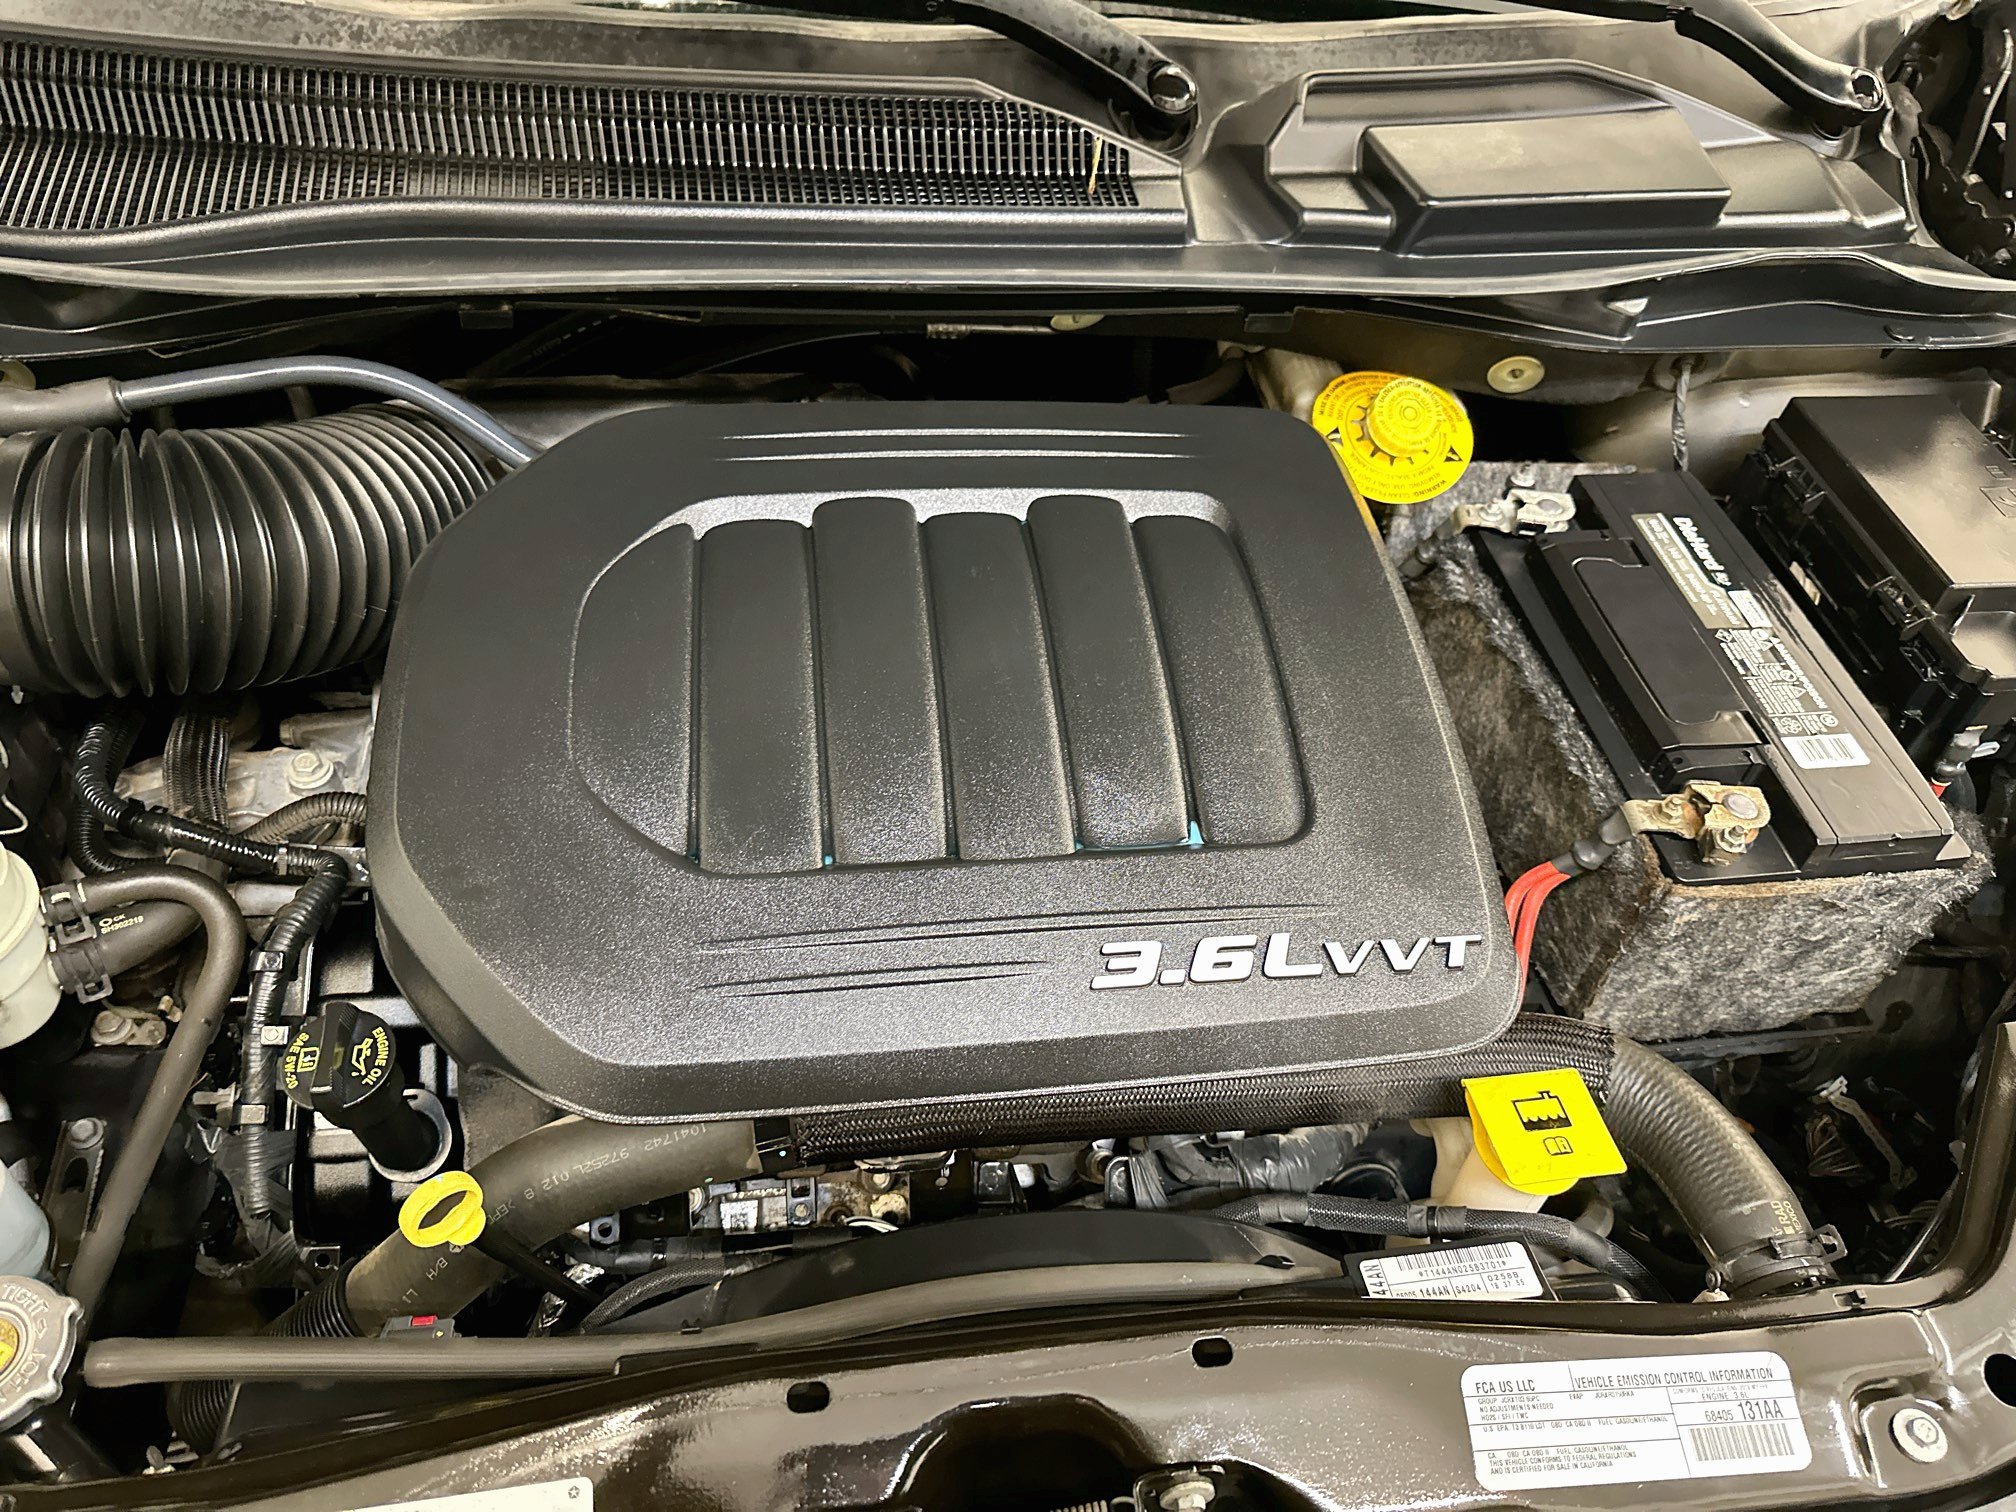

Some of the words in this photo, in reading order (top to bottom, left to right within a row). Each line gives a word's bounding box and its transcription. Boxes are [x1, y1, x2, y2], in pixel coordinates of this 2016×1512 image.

[1672, 517, 1725, 571] DieHard
[1090, 933, 1323, 990] 3.6L
[289, 1032, 310, 1054] SAE
[371, 1026, 389, 1067] ENGINE
[284, 1056, 299, 1090] 5W-20
[361, 1067, 382, 1086] OIL
[643, 1122, 708, 1151] 1041742
[1770, 1200, 1791, 1225] RAD
[1475, 1381, 1496, 1394] FCA
[1498, 1380, 1514, 1393] US
[1516, 1379, 1536, 1392] LLC
[1574, 1375, 1615, 1389] VEHICLE
[1616, 1373, 1662, 1387] EMISSION
[1663, 1370, 1708, 1385] CONTROL
[1709, 1367, 1774, 1383] INFORMATION
[1490, 1404, 1531, 1413] ADJUSTMENTS
[1531, 1402, 1554, 1410] NEEDED
[1702, 1392, 1729, 1401] ENGINE
[1704, 1409, 1734, 1422] 68405
[1737, 1399, 1784, 1421] 131AA
[1489, 1459, 1504, 1467] THIS
[1504, 1457, 1528, 1466] VEHICLE
[1530, 1455, 1562, 1464] CONFORMS
[1563, 1454, 1571, 1462] TO
[1572, 1453, 1597, 1462] FEDERAL
[1598, 1451, 1637, 1460] REGULATIONS
[1490, 1467, 1504, 1475] AND
[1504, 1466, 1511, 1474] IS
[1512, 1464, 1542, 1474] CERTIFIED
[1543, 1464, 1555, 1472] FOR
[1556, 1462, 1571, 1471] SALE
[1572, 1462, 1579, 1470] IN
[1579, 1460, 1614, 1469] CALIFORNIA
